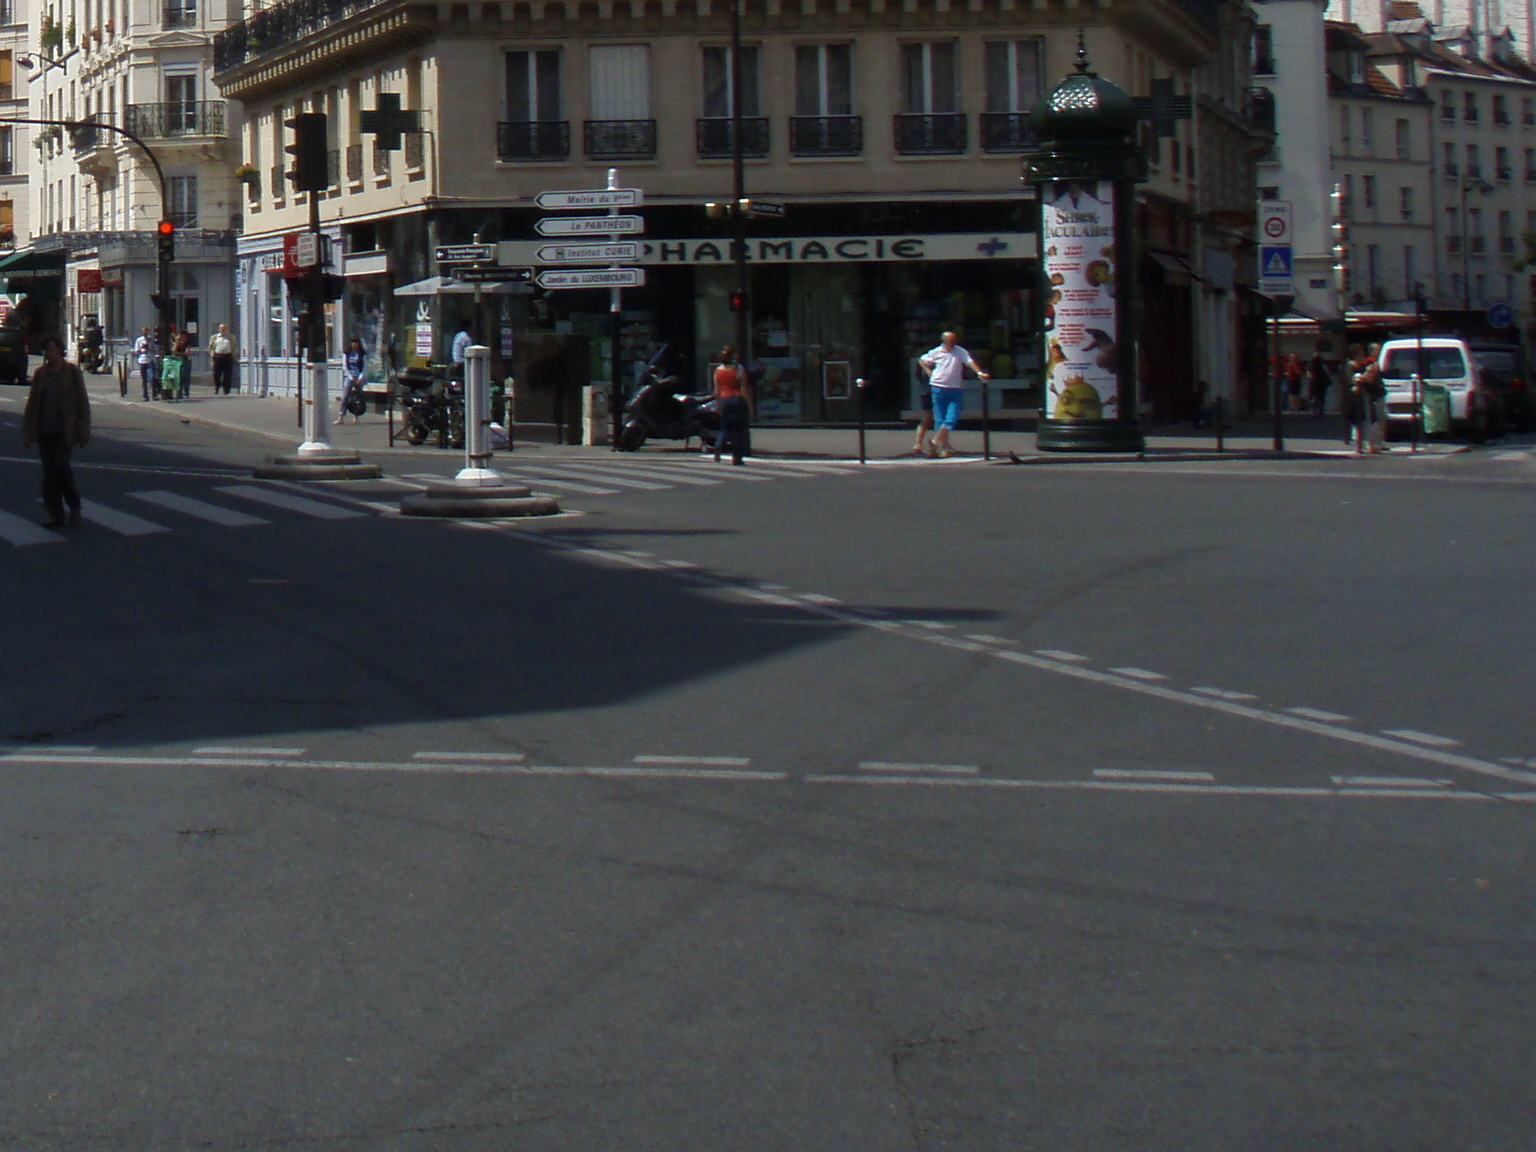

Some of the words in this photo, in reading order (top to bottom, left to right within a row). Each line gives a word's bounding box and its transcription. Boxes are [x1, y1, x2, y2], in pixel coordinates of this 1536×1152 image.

[567, 195, 594, 204] Mairie
[598, 195, 609, 203] du
[571, 222, 581, 231] Le
[567, 249, 601, 258] Institut
[604, 247, 632, 256] CURIE
[545, 276, 567, 284] Jardin
[570, 275, 580, 283] du
[582, 273, 632, 283] LUXEMBOURG
